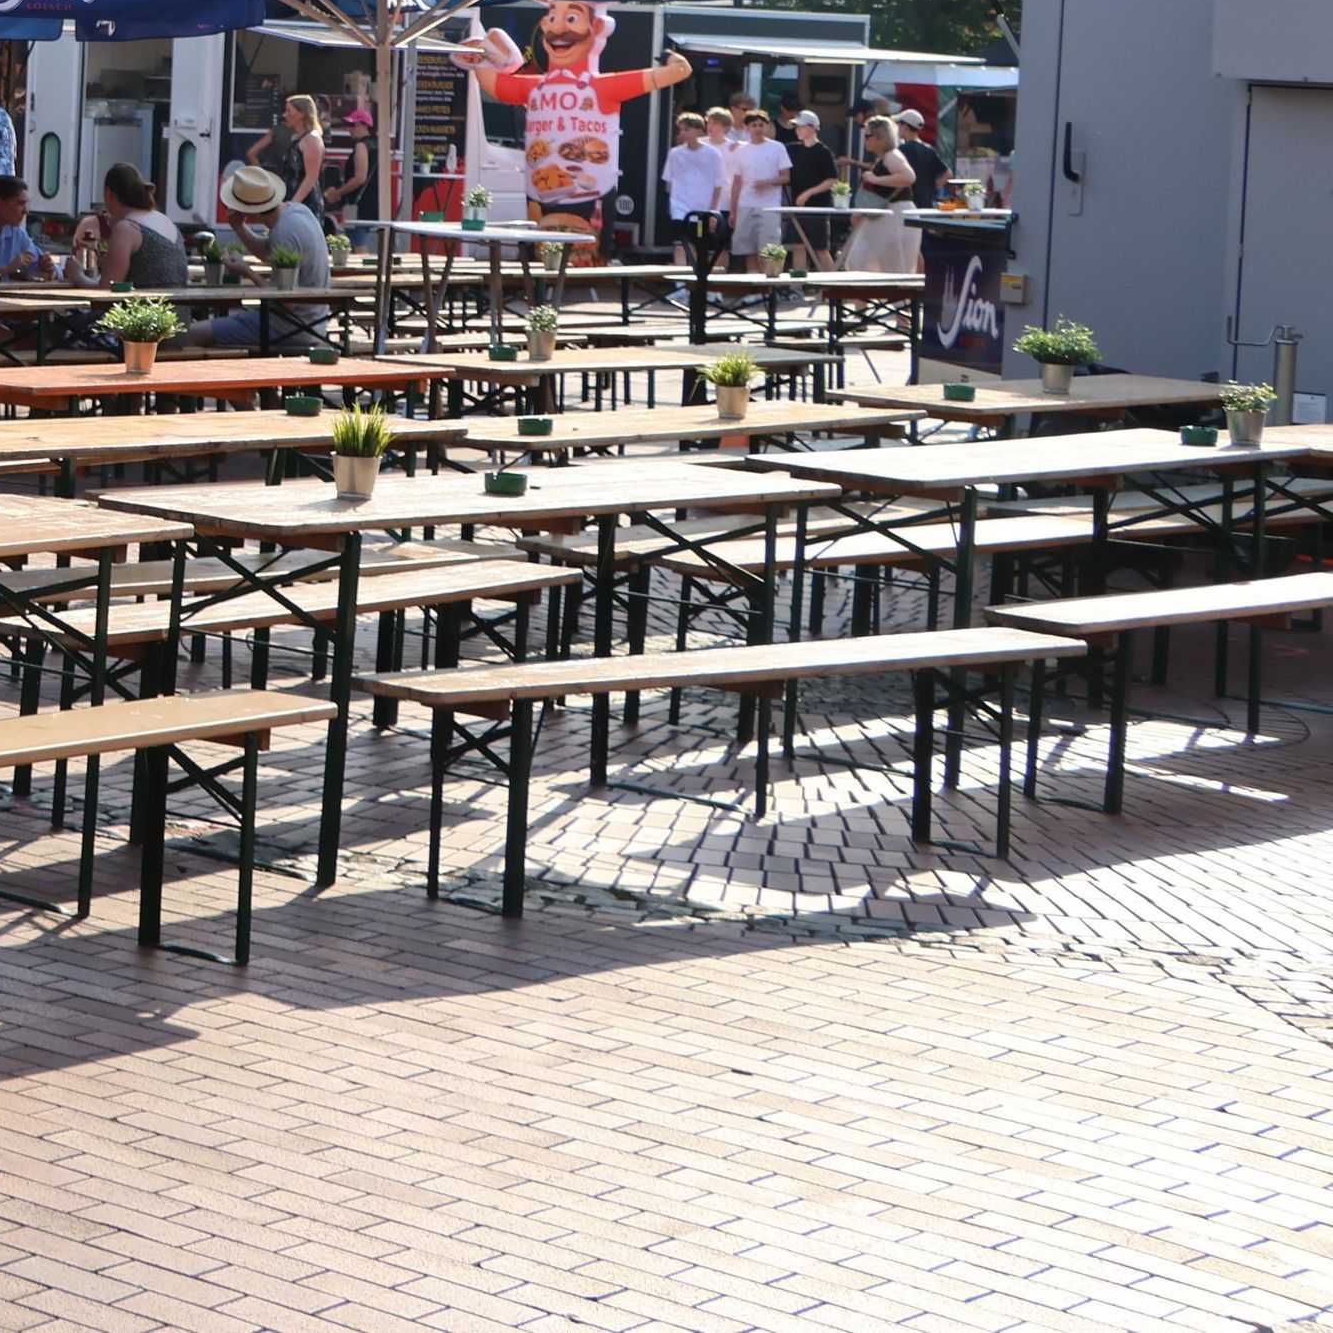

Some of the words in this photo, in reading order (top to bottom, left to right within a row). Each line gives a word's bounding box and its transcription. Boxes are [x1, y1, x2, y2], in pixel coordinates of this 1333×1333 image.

[540, 92, 579, 111] MO
[557, 116, 566, 132] &
[570, 116, 607, 133] Tacos
[937, 255, 1000, 350] Sion
